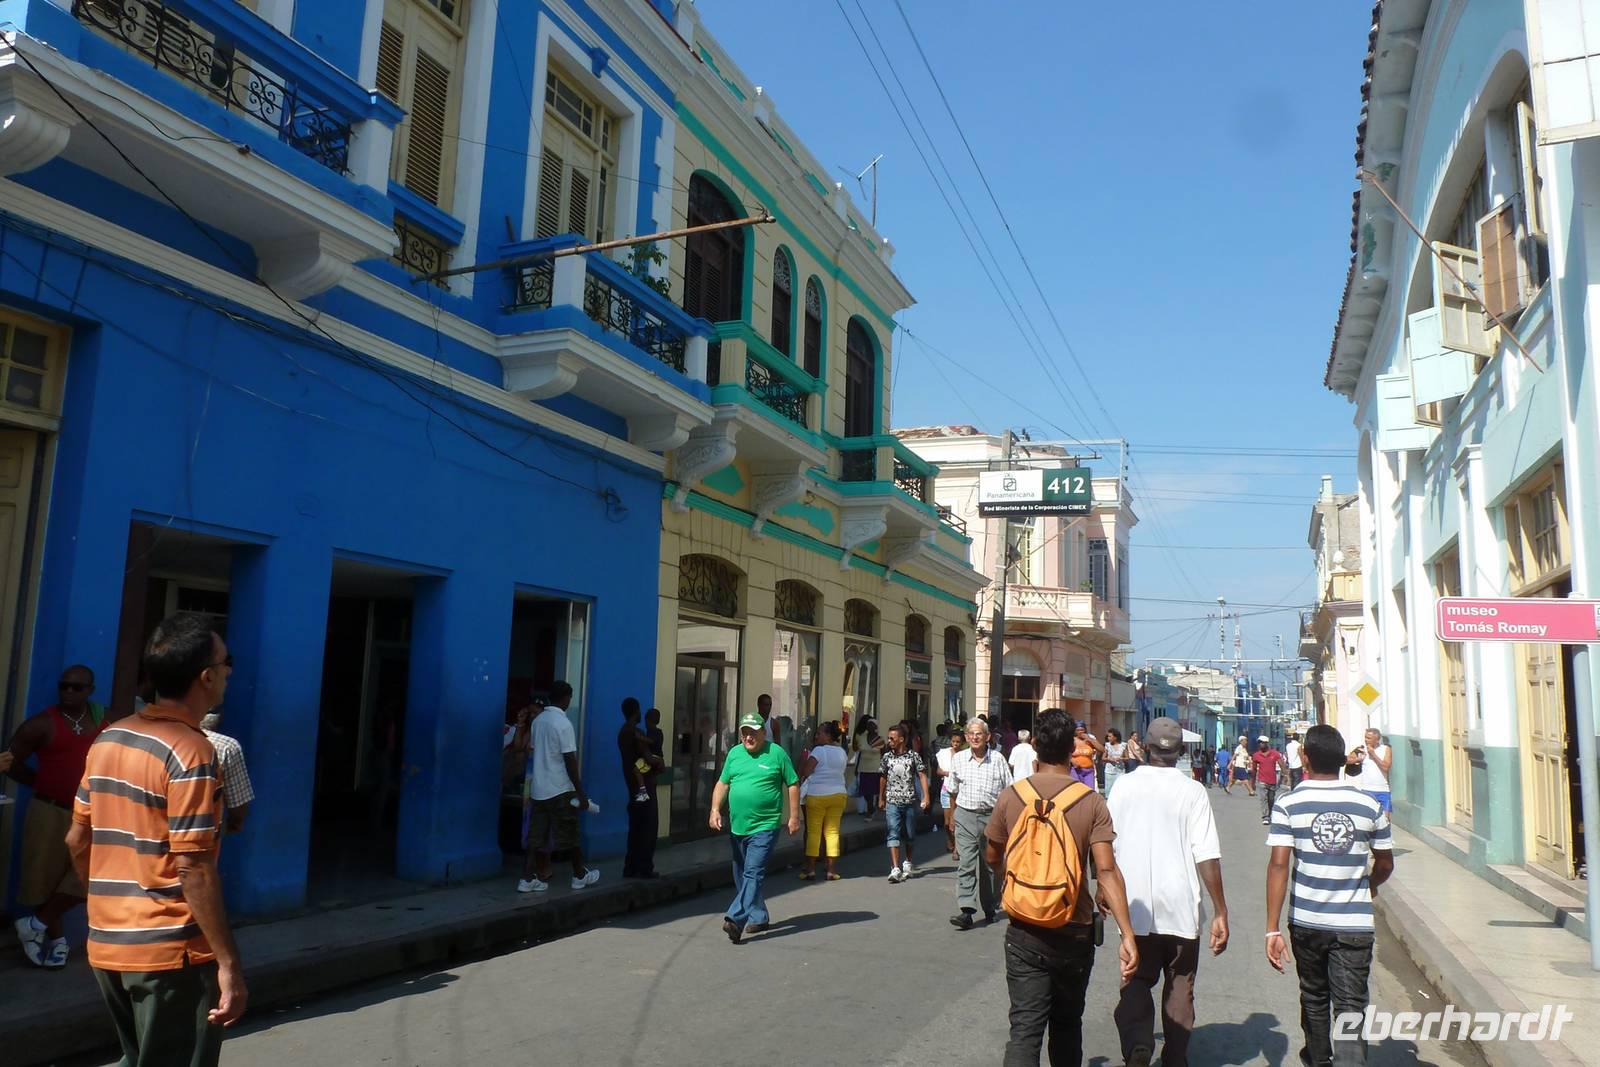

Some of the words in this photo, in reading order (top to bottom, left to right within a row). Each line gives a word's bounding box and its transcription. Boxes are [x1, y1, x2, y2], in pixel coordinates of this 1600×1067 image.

[1047, 477, 1085, 494] 412
[986, 491, 1035, 499] Panamericana
[1447, 606, 1498, 616] museo
[1447, 620, 1494, 633] Tomás
[1498, 621, 1548, 636] Romay
[1321, 824, 1347, 843] 52
